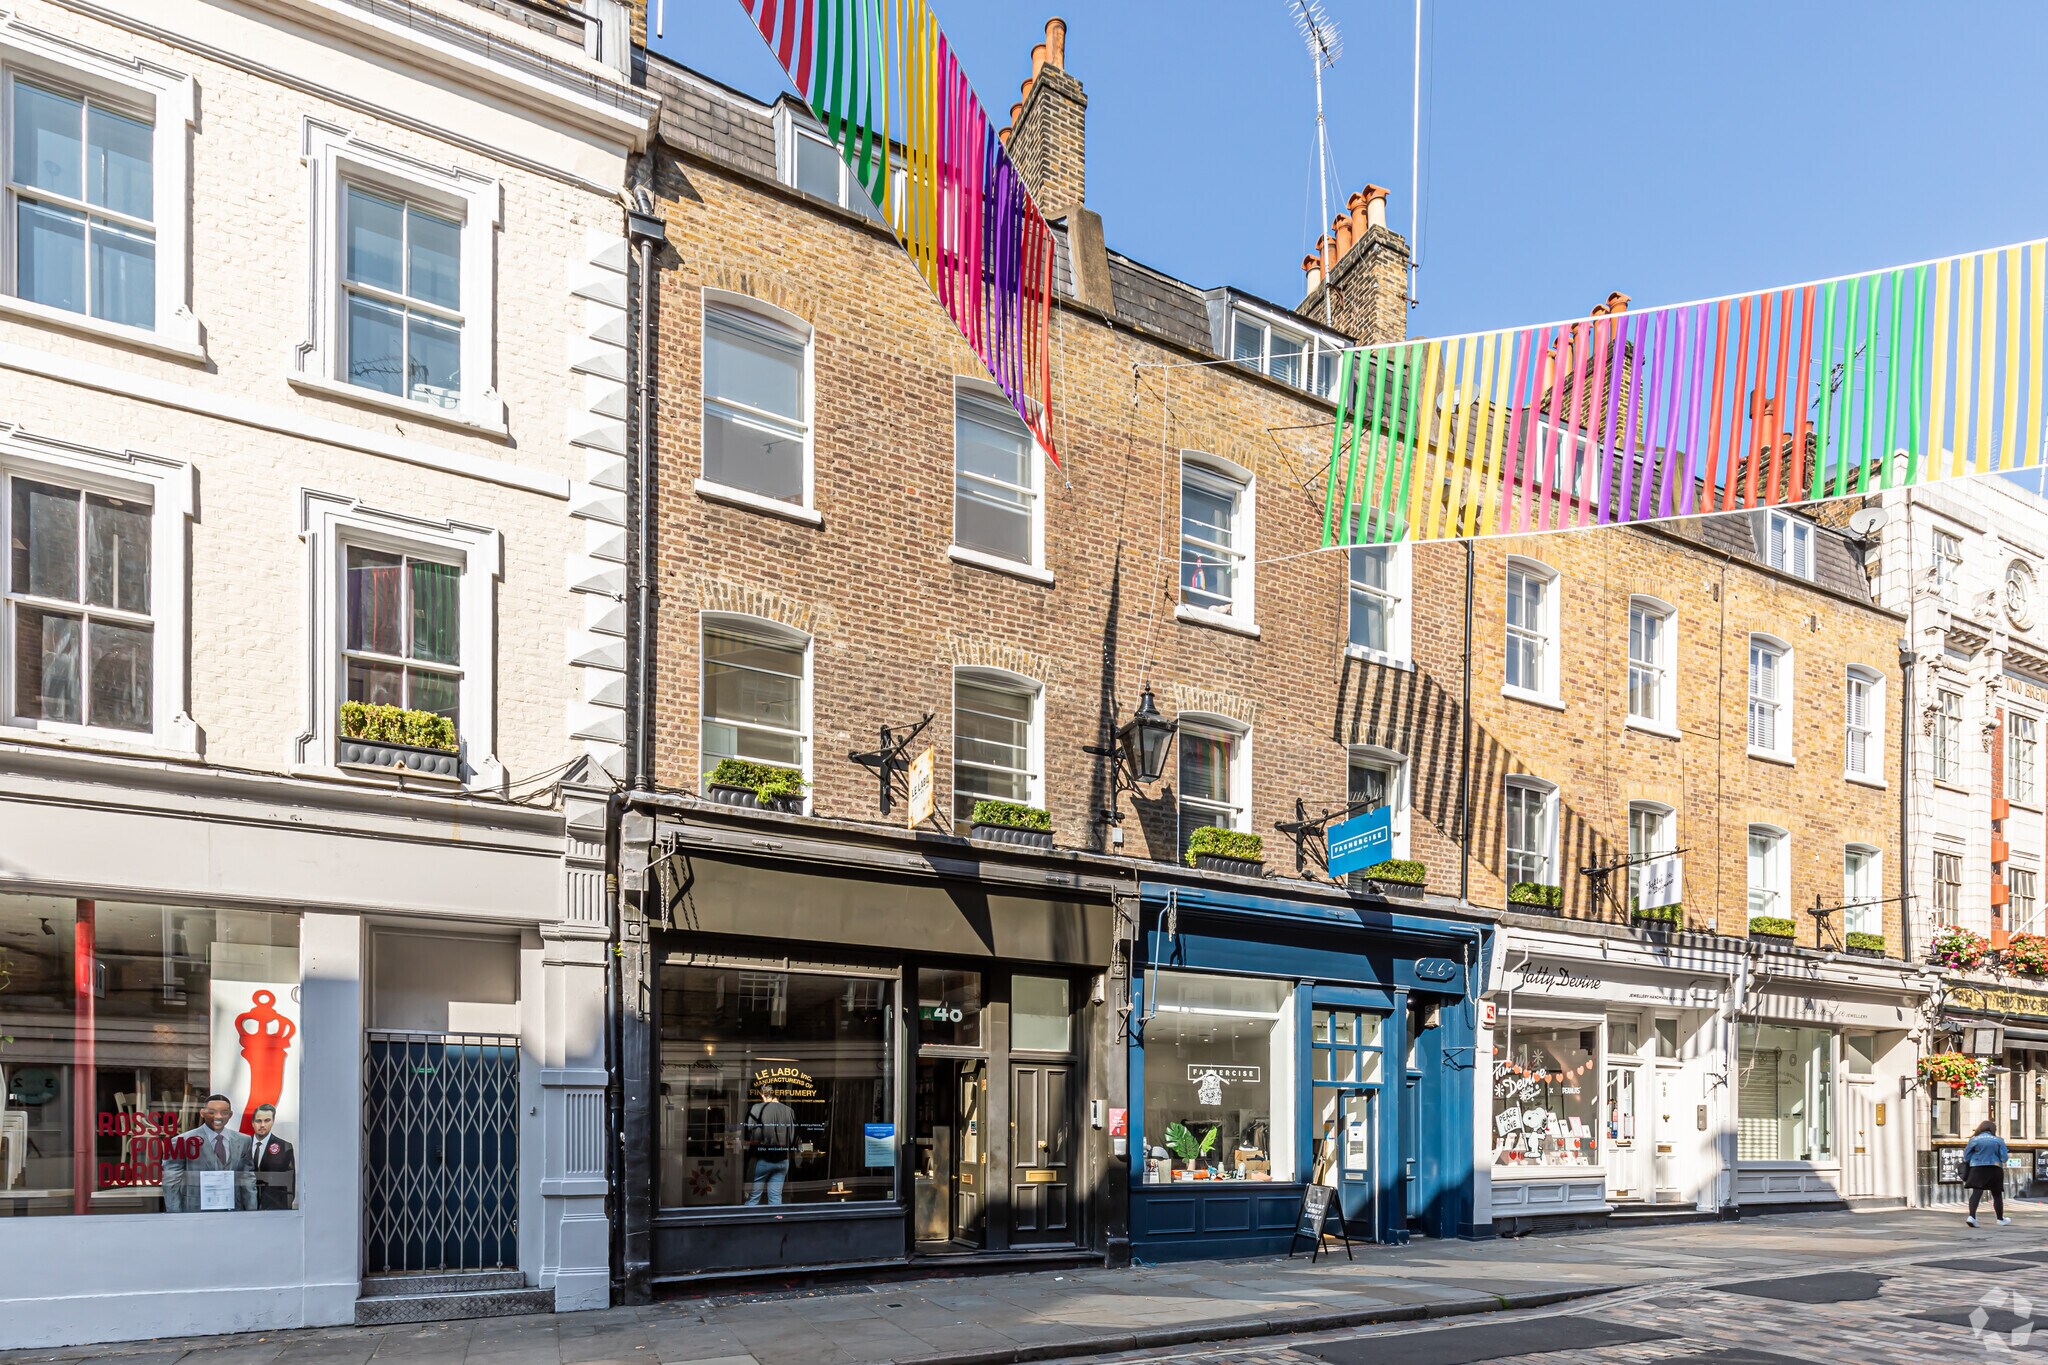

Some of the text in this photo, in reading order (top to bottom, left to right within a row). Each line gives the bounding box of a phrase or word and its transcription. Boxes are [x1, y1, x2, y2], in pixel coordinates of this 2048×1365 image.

[2025, 683, 2048, 704] BREW
[1334, 831, 1382, 853] FASHERCISE
[1426, 961, 1446, 977] 46
[1520, 962, 1601, 992] Tatty Devine
[755, 1067, 812, 1082] LE LABO Inc.
[1192, 1068, 1254, 1077] FAERCISE
[753, 1077, 804, 1087] MANUFACTURERS
[769, 1089, 817, 1097] PERFUMERY
[98, 1111, 178, 1137] ROSSO
[1499, 1108, 1517, 1124] PEACE
[1504, 1120, 1517, 1132] LOVE
[131, 1136, 200, 1161] POMO
[99, 1162, 163, 1187] DORO
